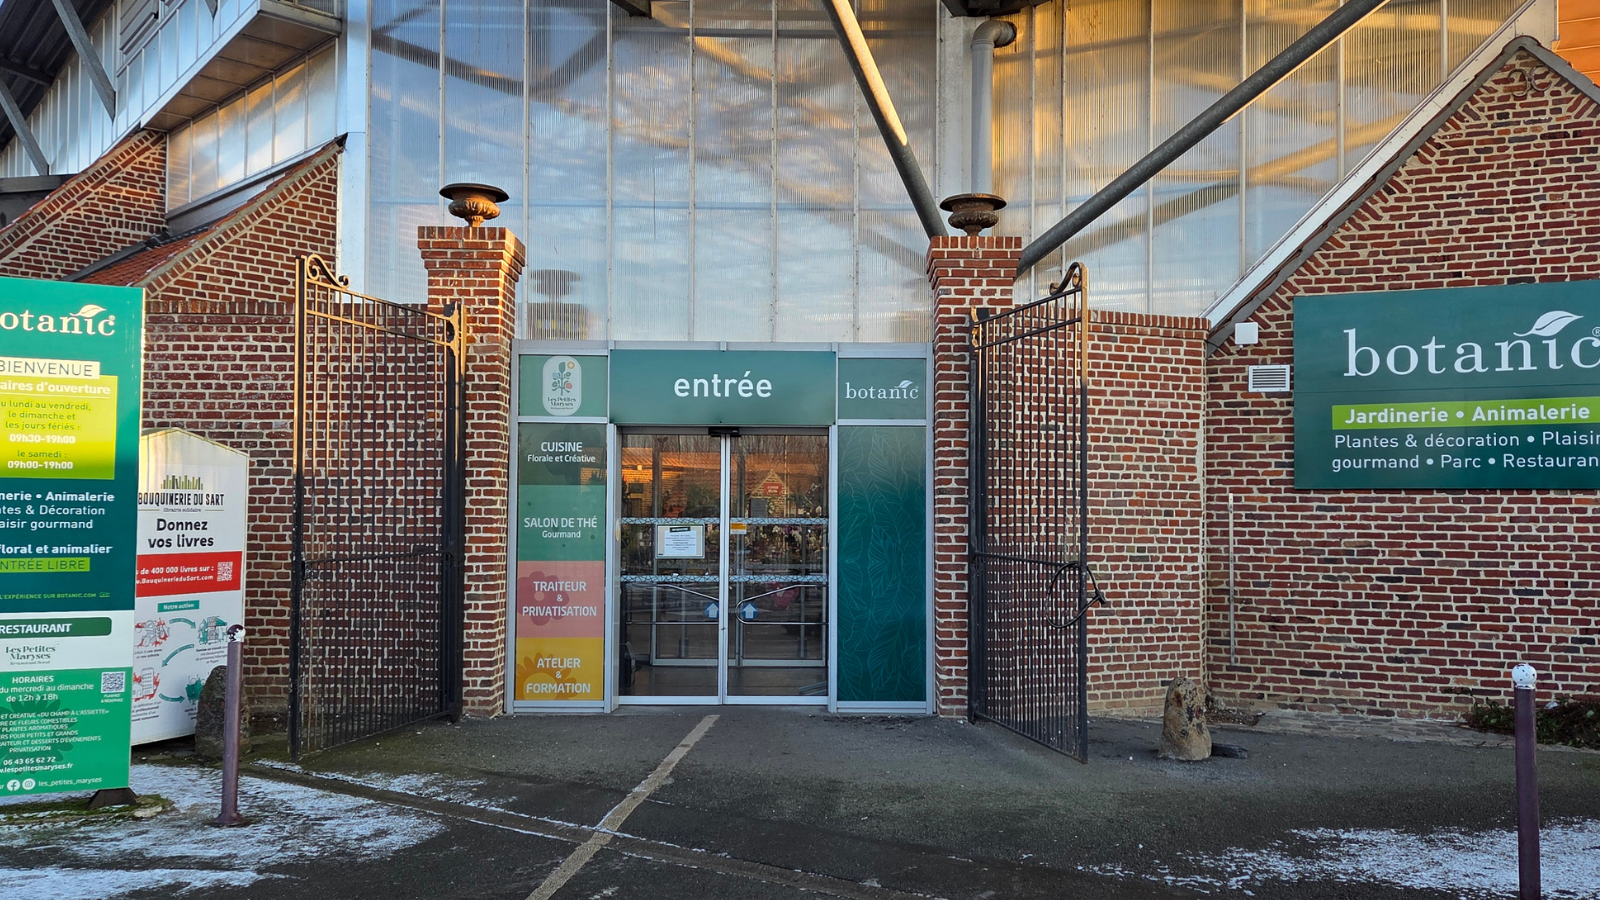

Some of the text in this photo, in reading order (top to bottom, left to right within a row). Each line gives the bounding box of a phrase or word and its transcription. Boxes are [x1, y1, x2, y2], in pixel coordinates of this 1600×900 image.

[1343, 328, 1600, 377] botanic
[36, 381, 111, 395] d'ouverture
[674, 371, 772, 398] entrée
[845, 382, 919, 399] botanic
[9, 400, 33, 408] lundi
[49, 402, 91, 411] vendredi,
[8, 410, 17, 418] le
[20, 410, 64, 420] dimanche
[1345, 403, 1590, 424] Jardinerie Animalerie
[6, 421, 20, 429] les
[22, 422, 46, 430] jours
[9, 433, 76, 444] 09h30-19h00
[1335, 434, 1399, 449] Plantes
[1405, 434, 1418, 448] &
[1424, 432, 1520, 448] décoration
[541, 441, 583, 452] CUISINE
[28, 450, 62, 458] samedi
[527, 454, 553, 462] Florale
[564, 454, 596, 462] Créative
[7, 460, 74, 470] 09h00-19h00
[1332, 453, 1600, 473] gourmand Parc Restauran
[45, 491, 115, 502] Animalerie
[138, 492, 224, 507] BOUQUINERIE DU SART
[25, 505, 35, 515] &
[39, 505, 106, 515] Décoration
[30, 519, 94, 531] gourmand
[156, 518, 208, 531] Donnez
[523, 515, 598, 528] SALON DE THÉ
[542, 530, 581, 538] Gourmand
[148, 534, 214, 548] vos livres
[35, 545, 49, 554] et
[51, 544, 113, 554] animalier
[47, 560, 85, 570] LIBRE
[533, 581, 587, 592] TRAITEUR
[556, 594, 563, 602] &
[522, 606, 597, 617] PRIVATISATION
[0, 623, 72, 634] RESTAURANT
[23, 645, 56, 653] Petites
[536, 658, 581, 668] ATELIER
[12, 675, 54, 684] HORAIRES
[555, 671, 562, 679] &
[11, 685, 44, 693] mercredi
[57, 683, 94, 691] dimanche
[526, 683, 591, 694] FORMATION
[18, 694, 34, 702] 12h
[43, 693, 58, 701] 18h
